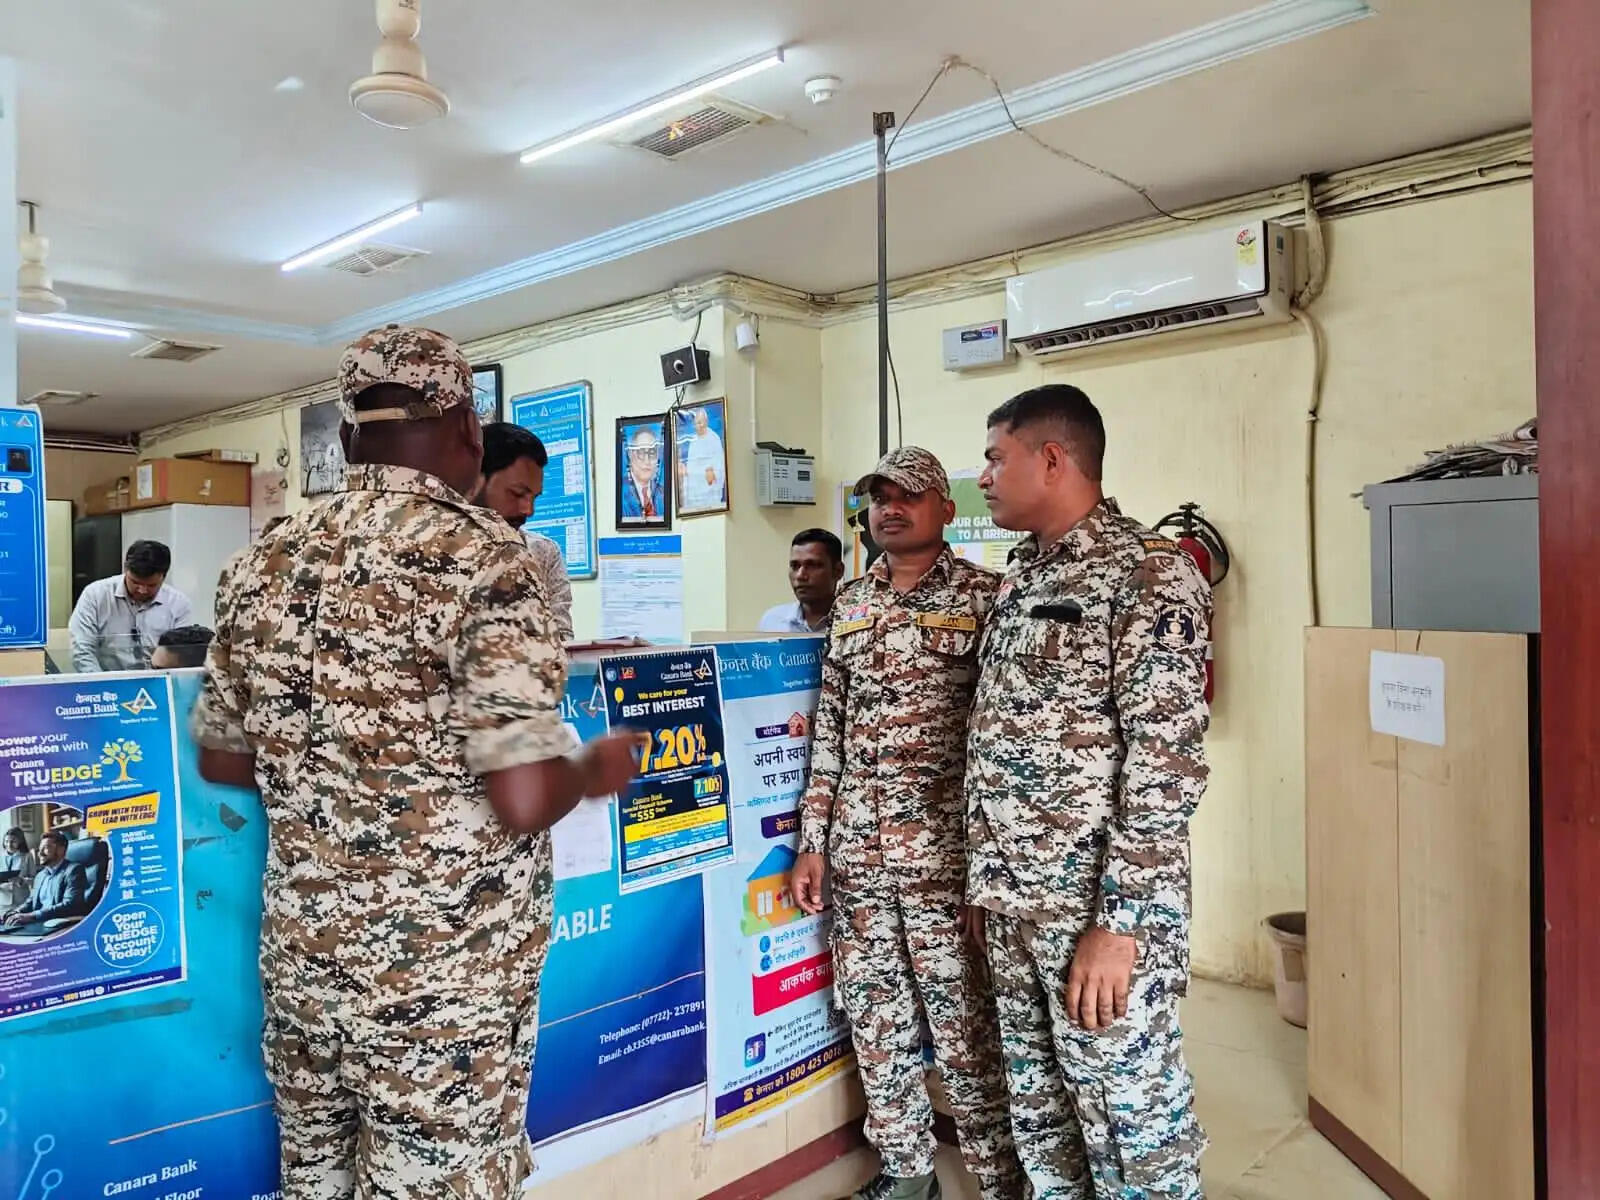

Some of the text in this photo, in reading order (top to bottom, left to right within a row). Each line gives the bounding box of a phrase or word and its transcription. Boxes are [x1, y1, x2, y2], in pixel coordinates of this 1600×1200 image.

[957, 529, 971, 541] TO
[973, 529, 982, 540] A
[751, 652, 773, 671] बैंक
[779, 651, 816, 668] Canara
[55, 706, 91, 717] Canara
[93, 702, 120, 714] Bank
[622, 695, 706, 719] BEST INTEREST
[40, 732, 69, 745] your
[0, 740, 89, 758] stitution with
[753, 745, 785, 768] अपनी
[10, 759, 45, 770] Canara
[11, 763, 103, 788] TRUEDGE
[761, 773, 777, 789] पर
[778, 768, 800, 786] ऋण
[637, 807, 655, 822] 555
[112, 911, 147, 924] Open
[114, 919, 145, 932] Your
[101, 925, 158, 944] TruEDGE
[104, 935, 158, 953] Account
[108, 944, 152, 961] Today!
[779, 966, 815, 993] आकर्षक
[600, 1022, 641, 1045] Telephone:
[674, 999, 705, 1017] 237891
[598, 1047, 622, 1066] Email:
[786, 1062, 806, 1083] 1800
[807, 1054, 822, 1072] 425
[103, 1158, 198, 1197] Canara Bank
